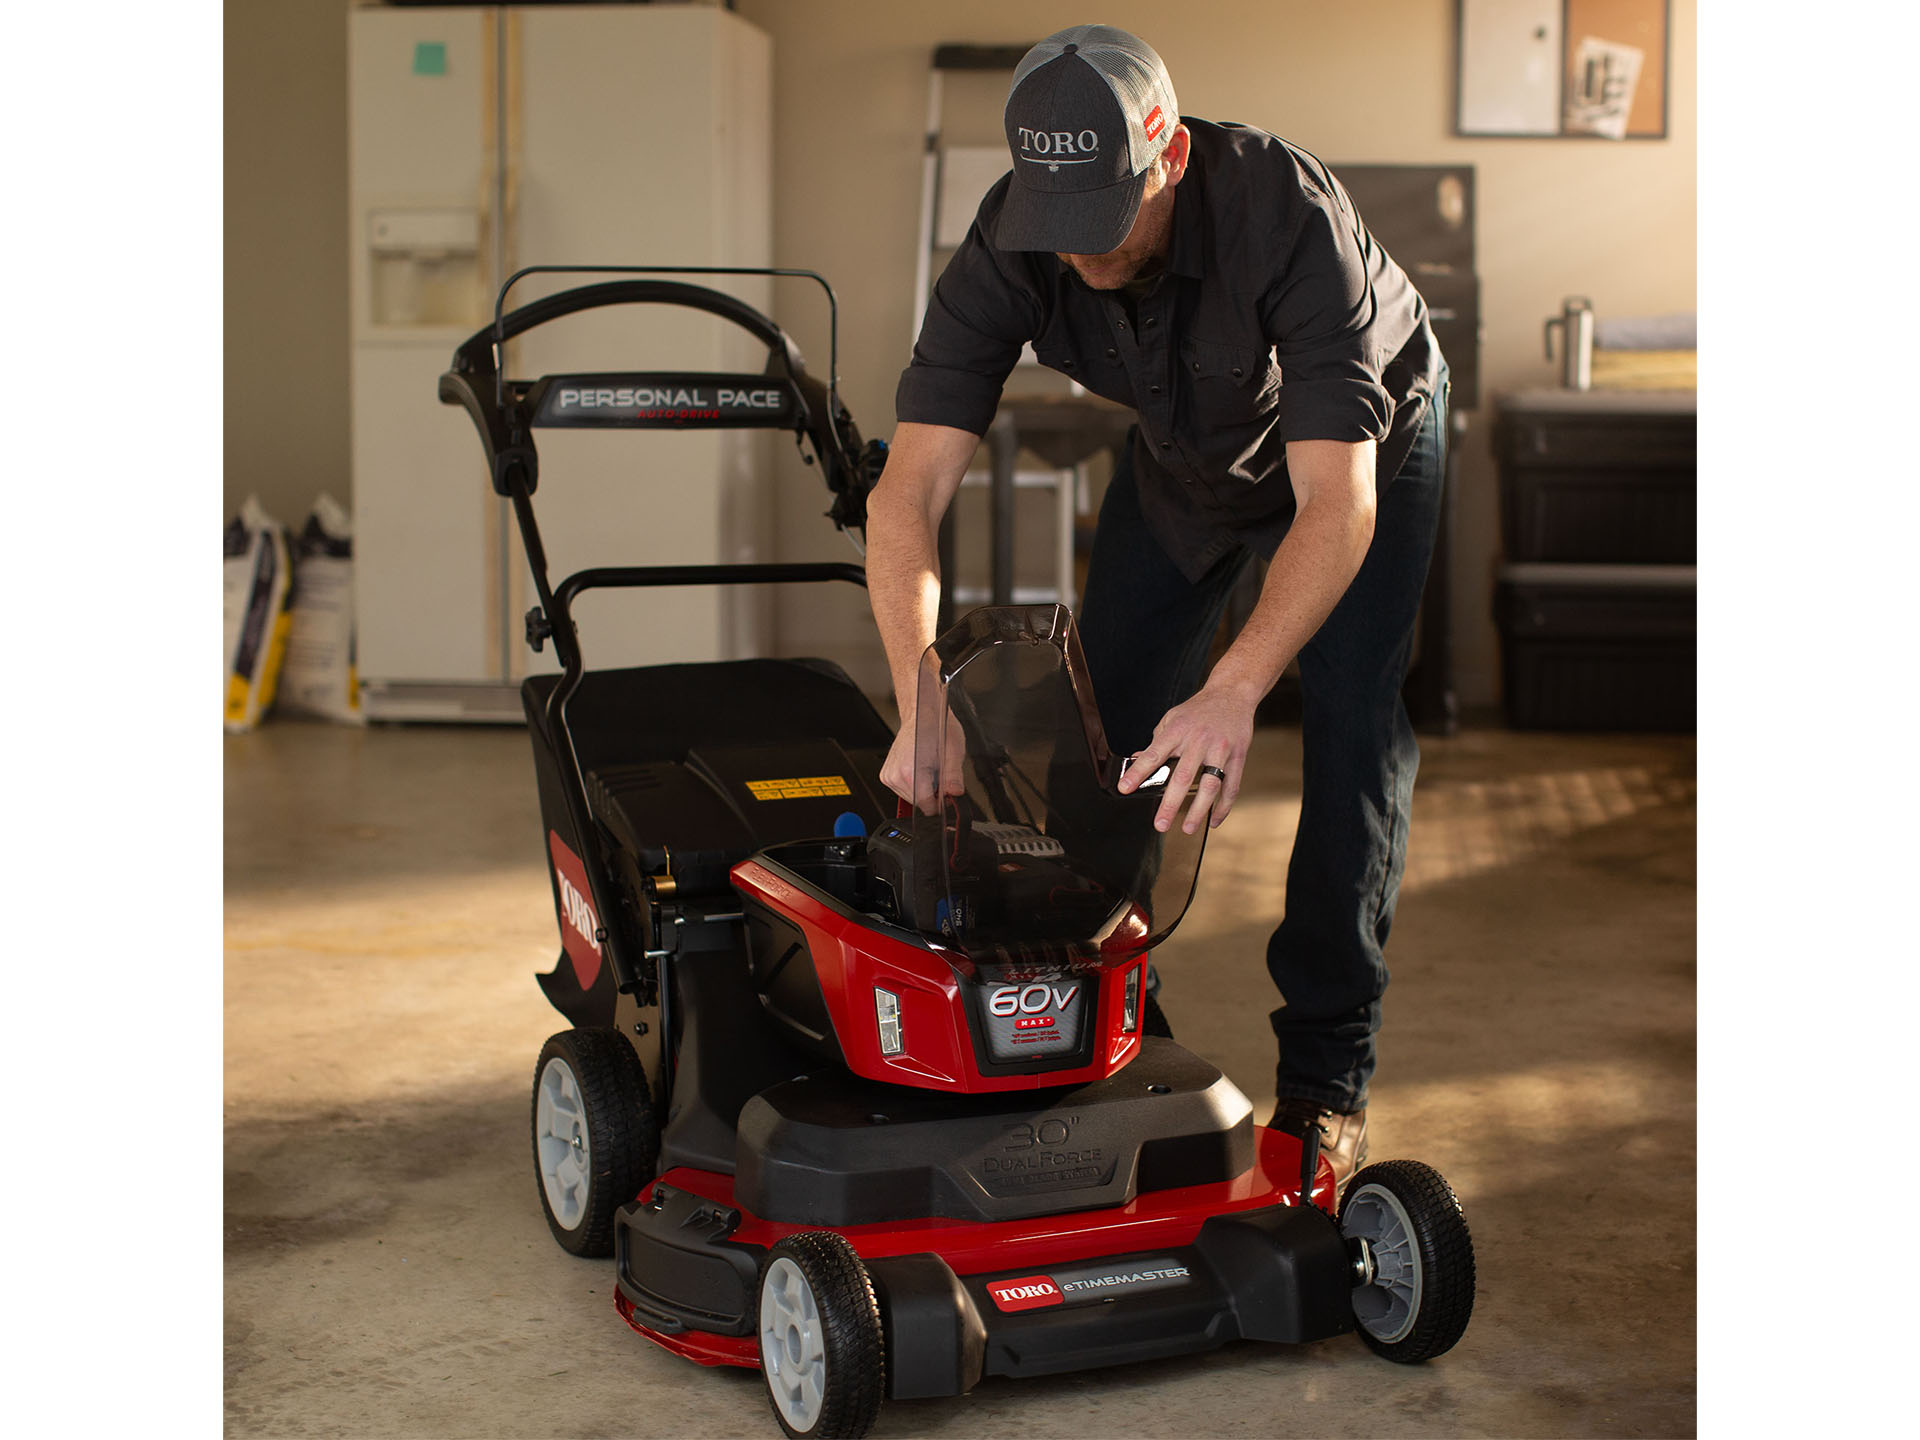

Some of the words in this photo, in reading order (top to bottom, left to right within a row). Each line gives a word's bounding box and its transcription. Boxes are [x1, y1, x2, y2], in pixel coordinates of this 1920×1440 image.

[1145, 111, 1164, 135] TORO
[1018, 126, 1098, 154] TORO
[559, 389, 707, 408] PERSONAL
[717, 389, 781, 408] PACE
[995, 1283, 1058, 1302] TORO
[1063, 1266, 1190, 1292] eTIMEMASTER
